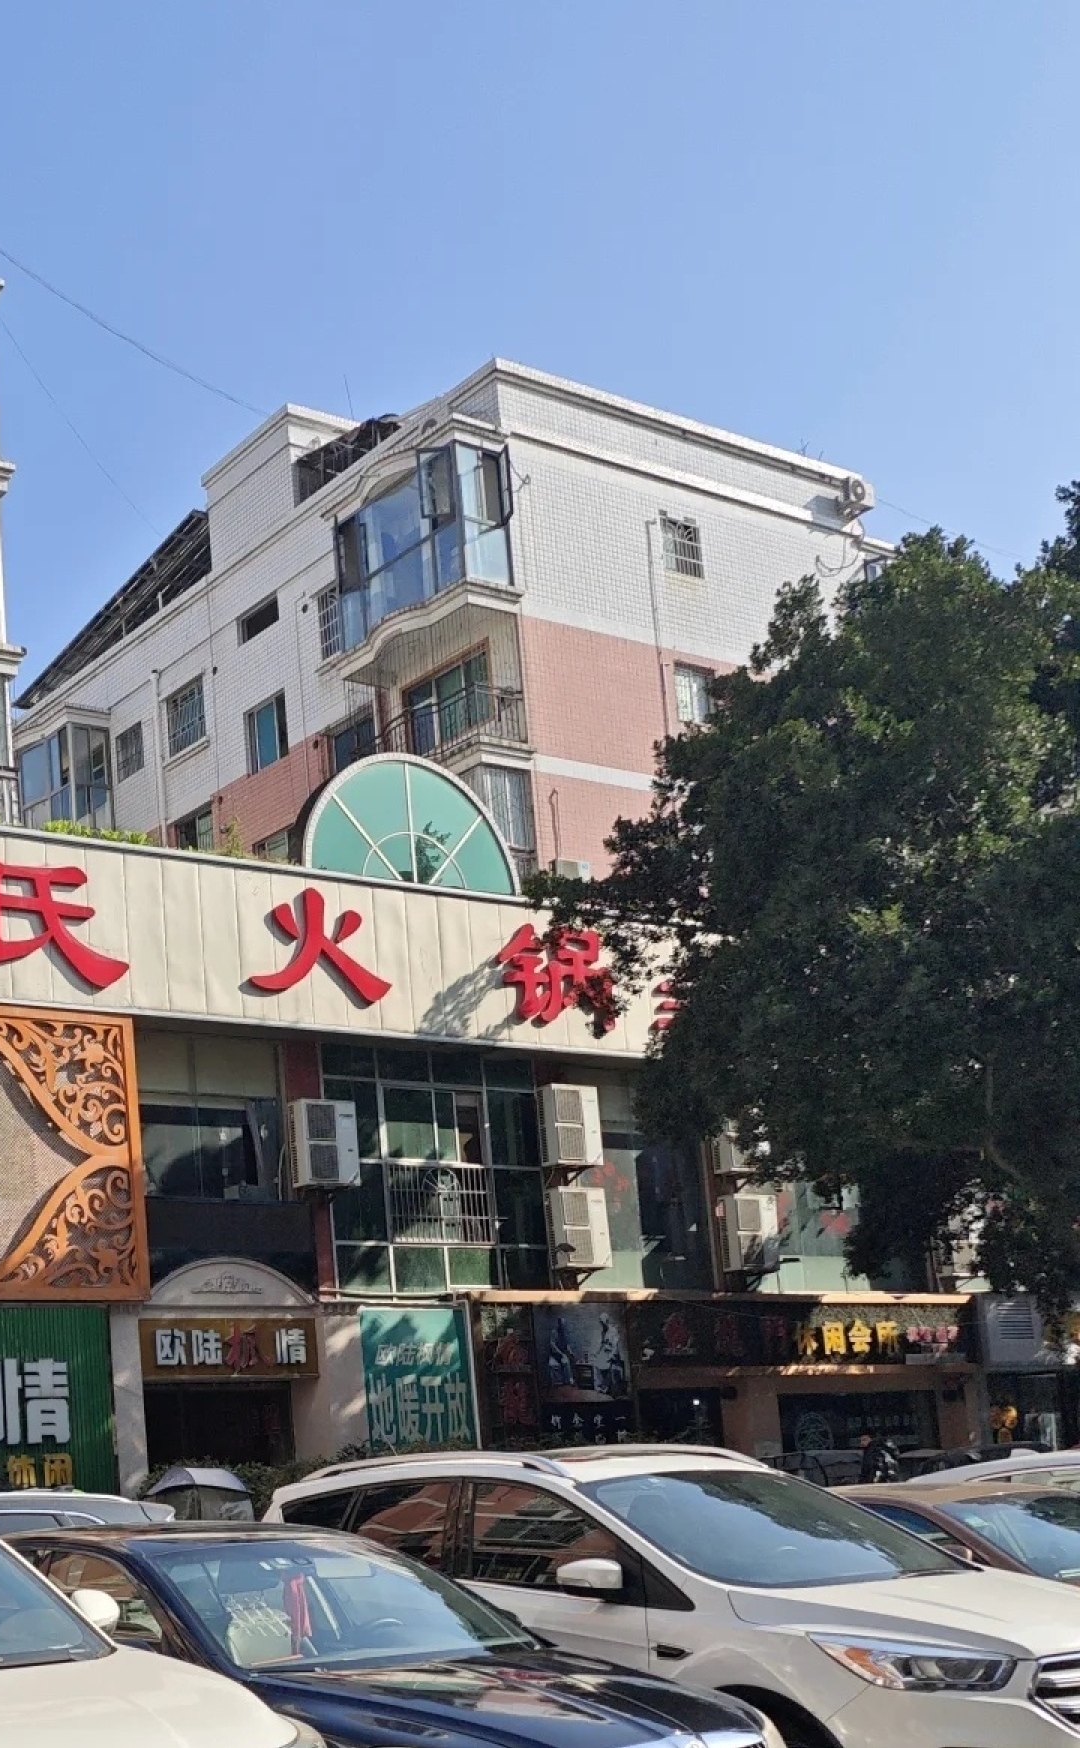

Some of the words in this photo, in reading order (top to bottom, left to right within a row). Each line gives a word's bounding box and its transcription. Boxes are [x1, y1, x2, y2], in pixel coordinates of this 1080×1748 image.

[156, 1322, 307, 1373] 欧陆枫情
[368, 1371, 472, 1444] 地暖开放
